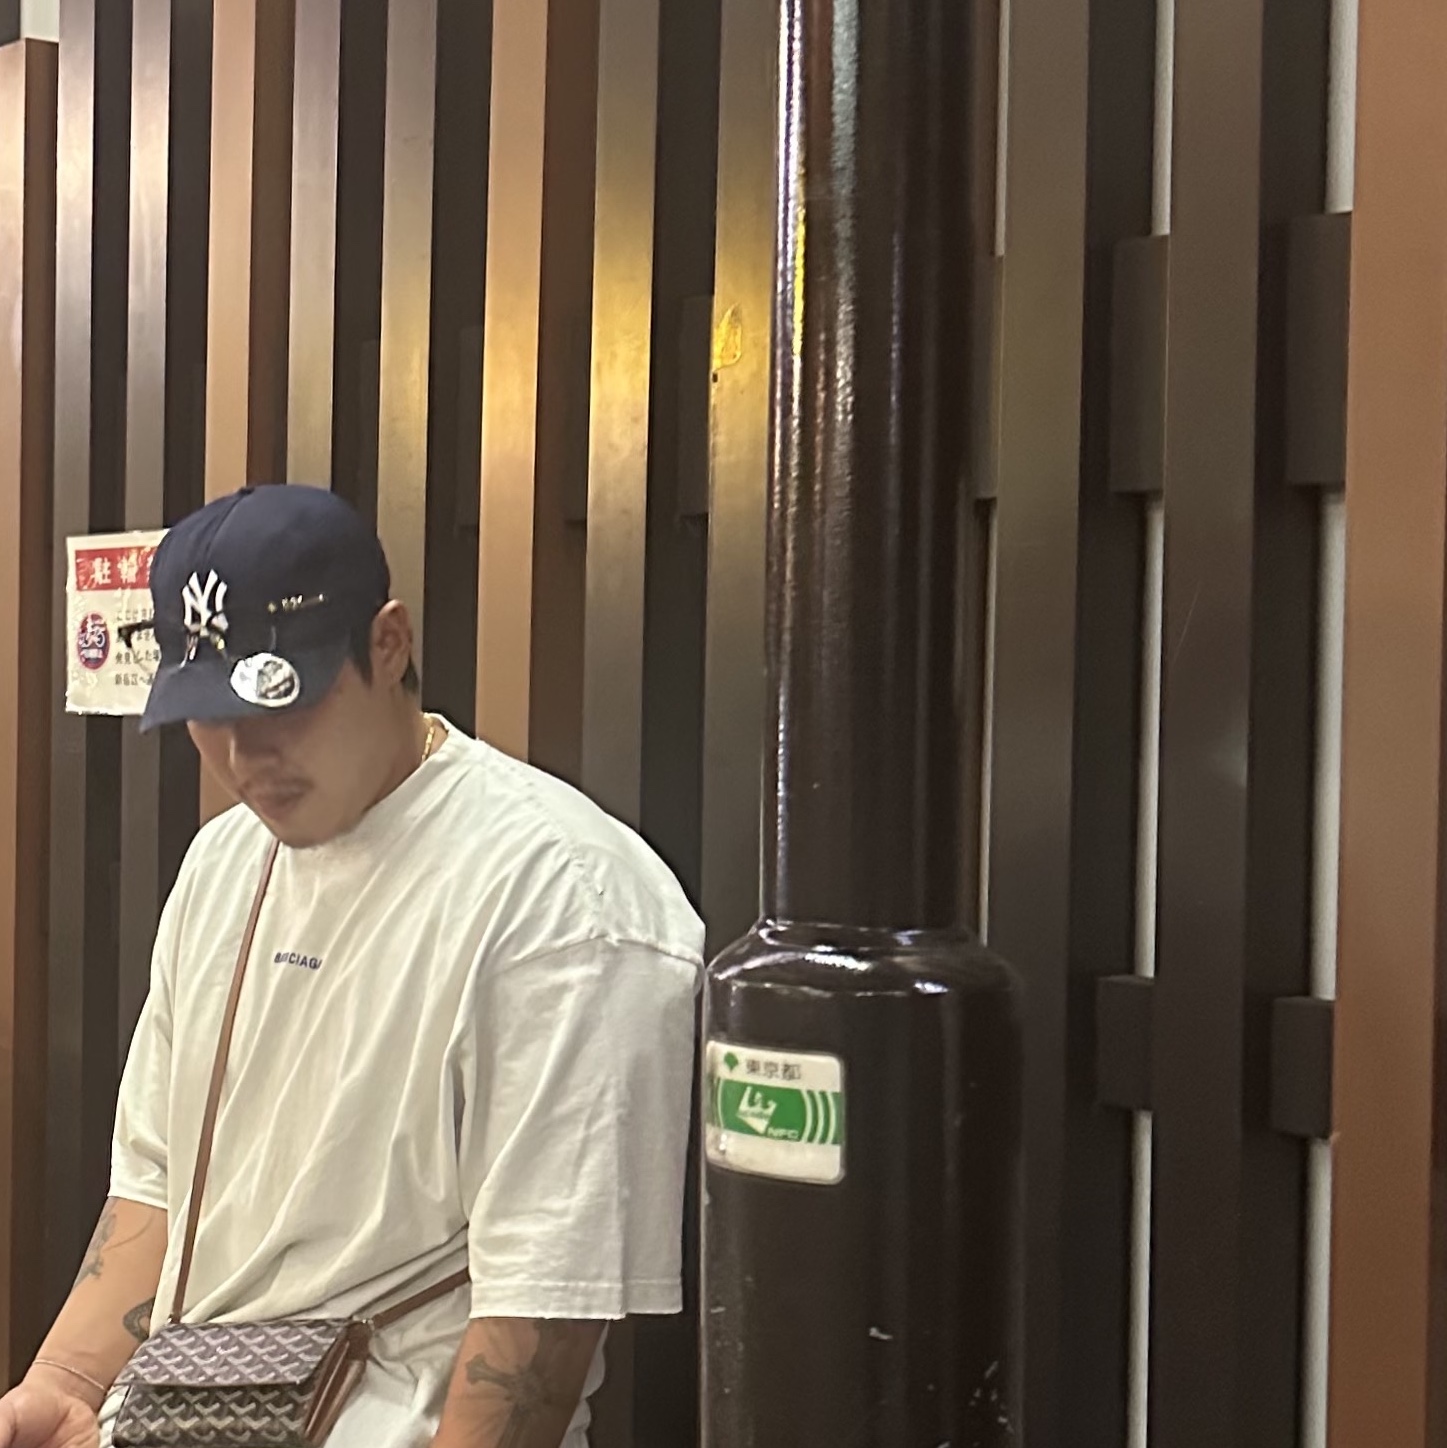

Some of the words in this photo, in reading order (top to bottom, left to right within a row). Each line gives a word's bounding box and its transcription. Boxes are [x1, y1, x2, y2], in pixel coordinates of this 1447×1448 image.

[181, 568, 229, 637] NY
[746, 1059, 802, 1081] 東京都
